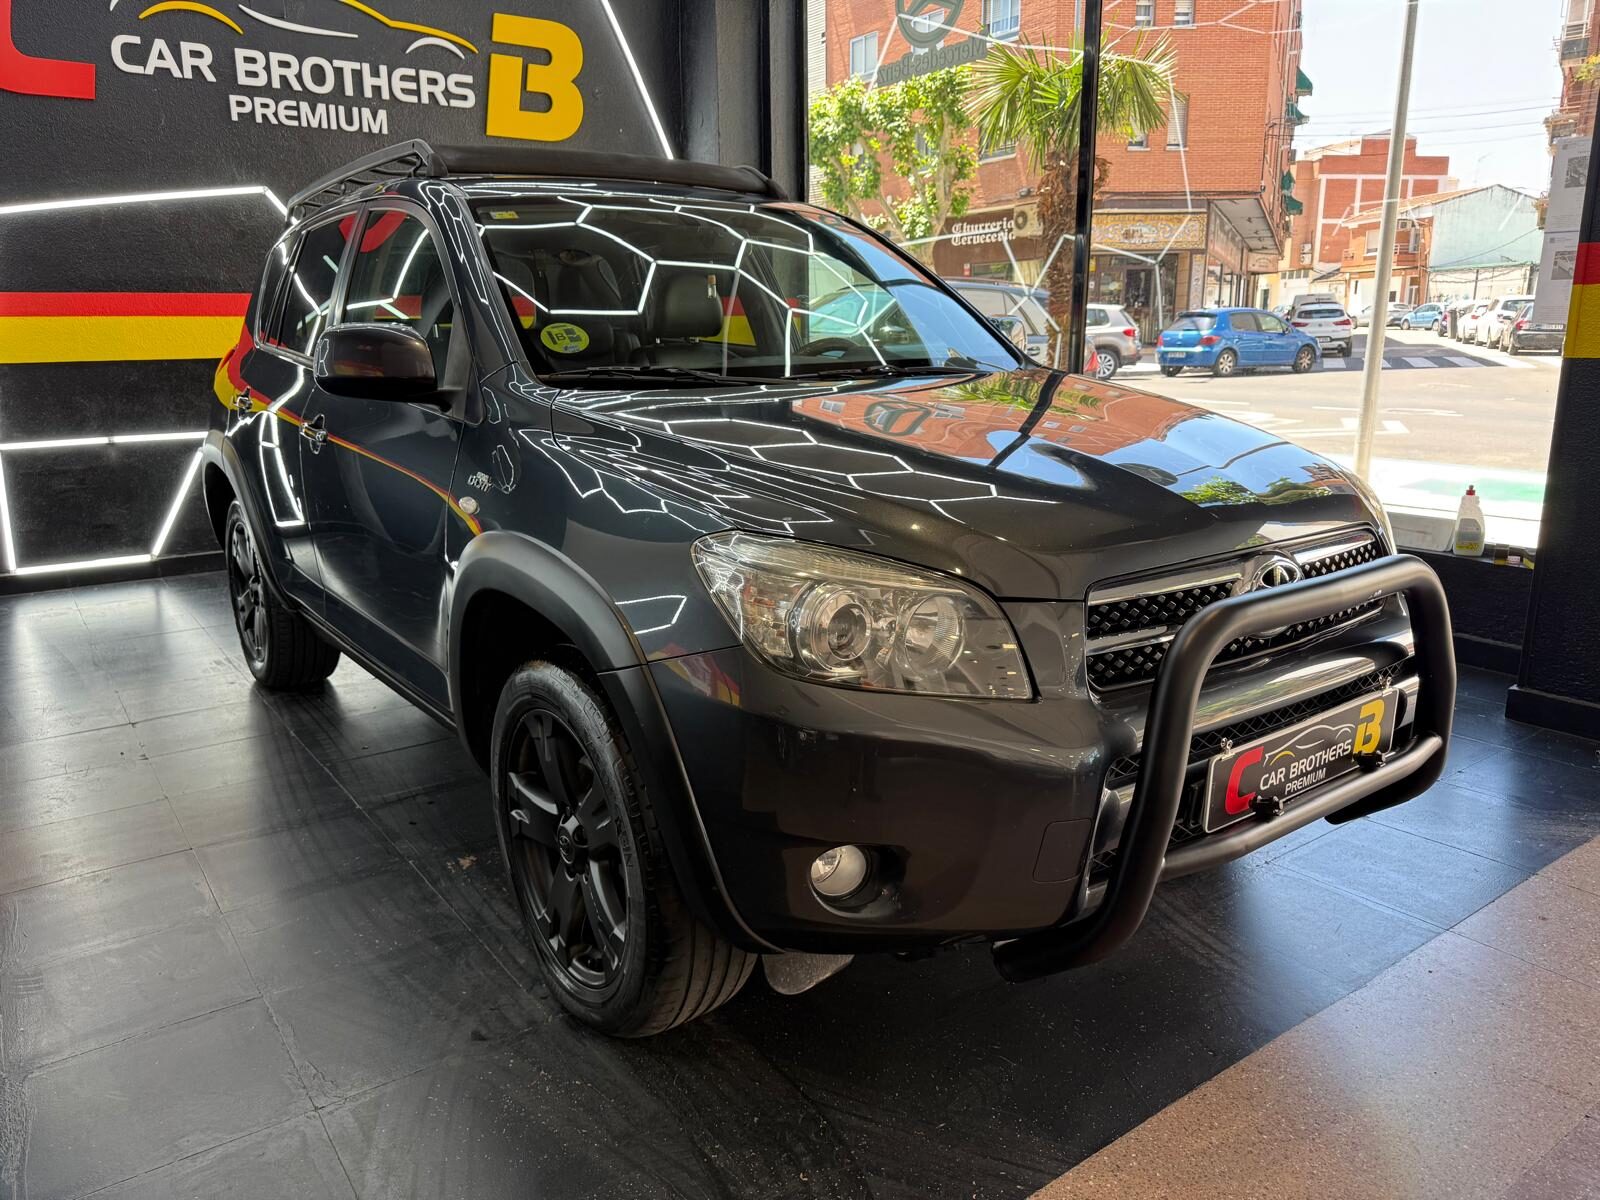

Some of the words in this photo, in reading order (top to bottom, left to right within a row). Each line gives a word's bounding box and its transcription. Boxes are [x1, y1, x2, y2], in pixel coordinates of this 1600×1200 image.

[110, 34, 217, 83] CAR
[234, 47, 476, 109] BROTHERS
[487, 12, 584, 142] B
[230, 95, 389, 135] PREMIUM
[1225, 746, 1264, 815] C
[1260, 767, 1285, 791] CAR
[1289, 739, 1352, 780] BROTHERS
[1285, 768, 1326, 796] PREMIUM
